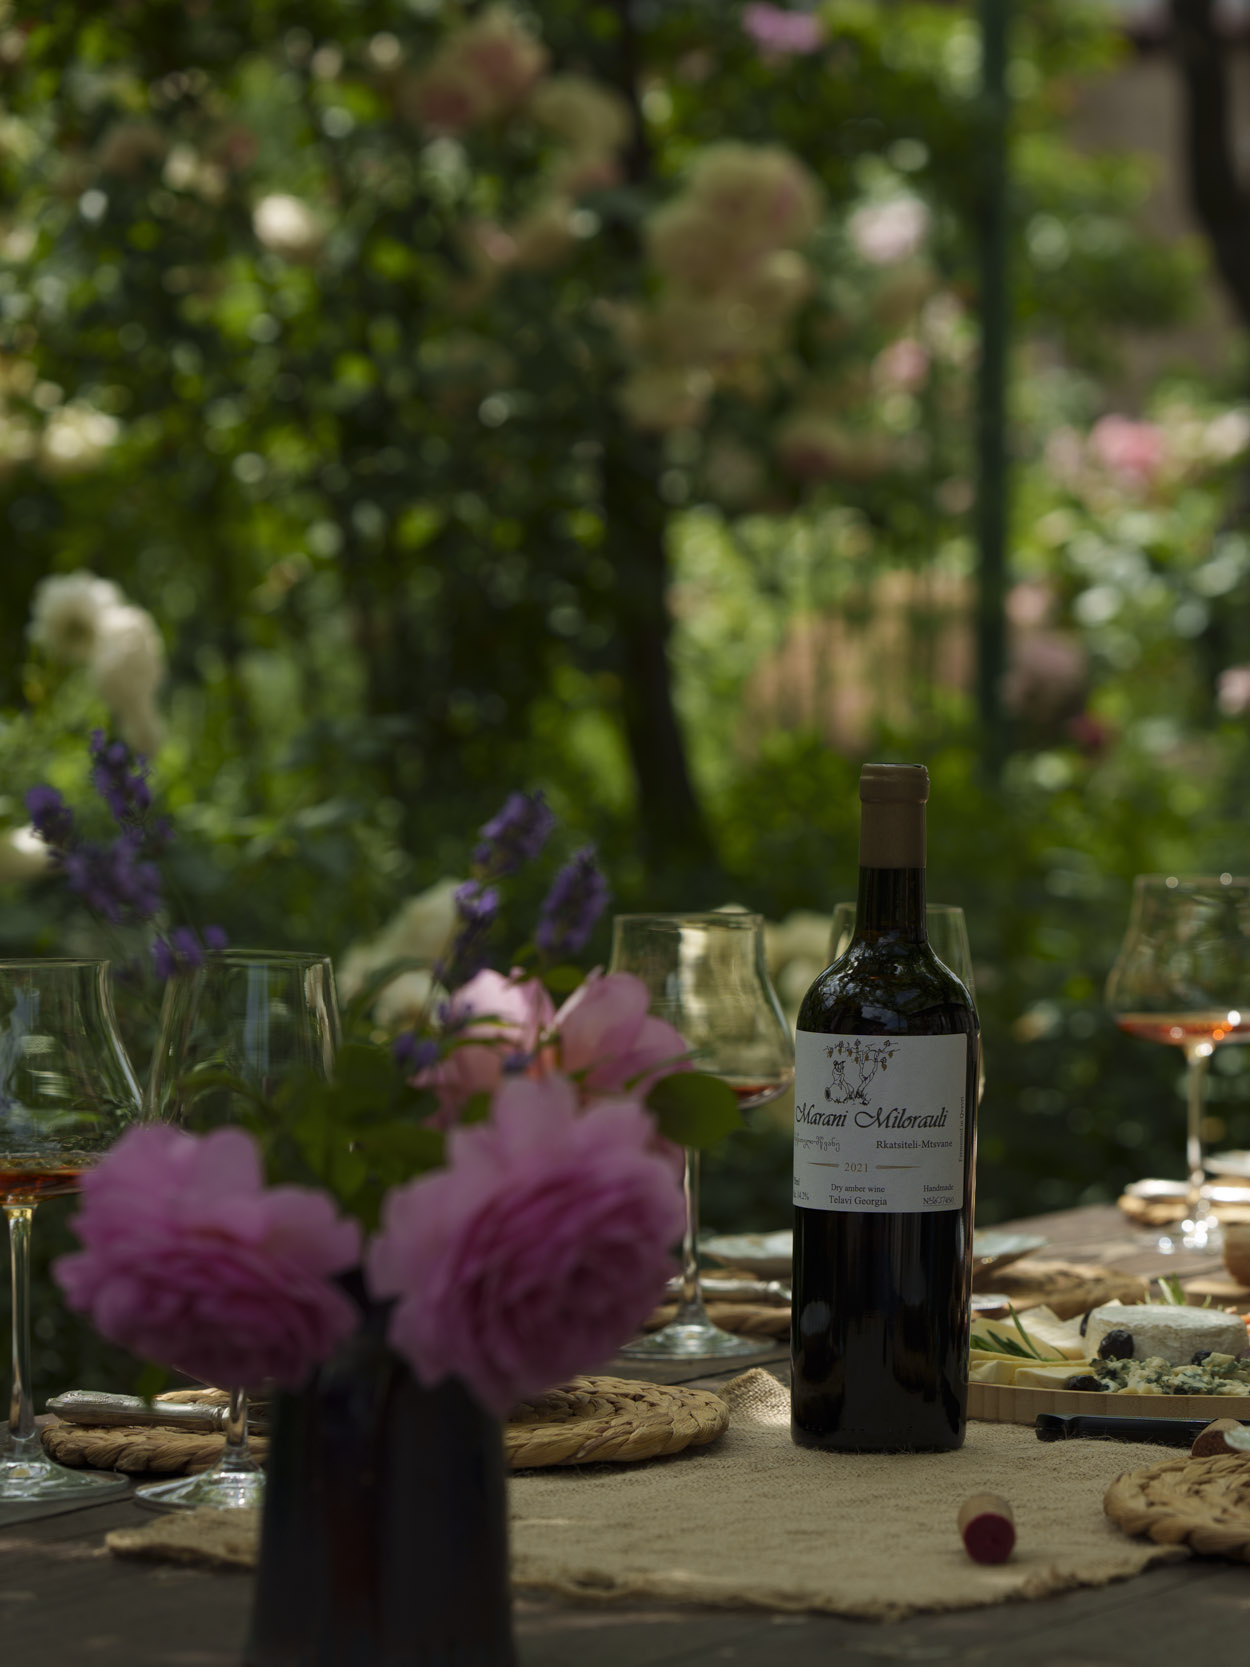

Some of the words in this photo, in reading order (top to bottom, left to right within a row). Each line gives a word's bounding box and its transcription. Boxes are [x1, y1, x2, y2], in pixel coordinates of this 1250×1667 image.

[796, 1102, 849, 1128] Marani
[854, 1107, 949, 1129] Milorauli
[876, 1139, 953, 1150] Rkatsiteli-Mtsvane
[844, 1162, 869, 1173] 2021
[831, 1183, 844, 1193] Dry
[845, 1184, 866, 1193] amber
[868, 1185, 886, 1193] wine
[923, 1184, 954, 1192] Handmade
[829, 1194, 853, 1205] Telavi
[854, 1196, 888, 1207] Georgia
